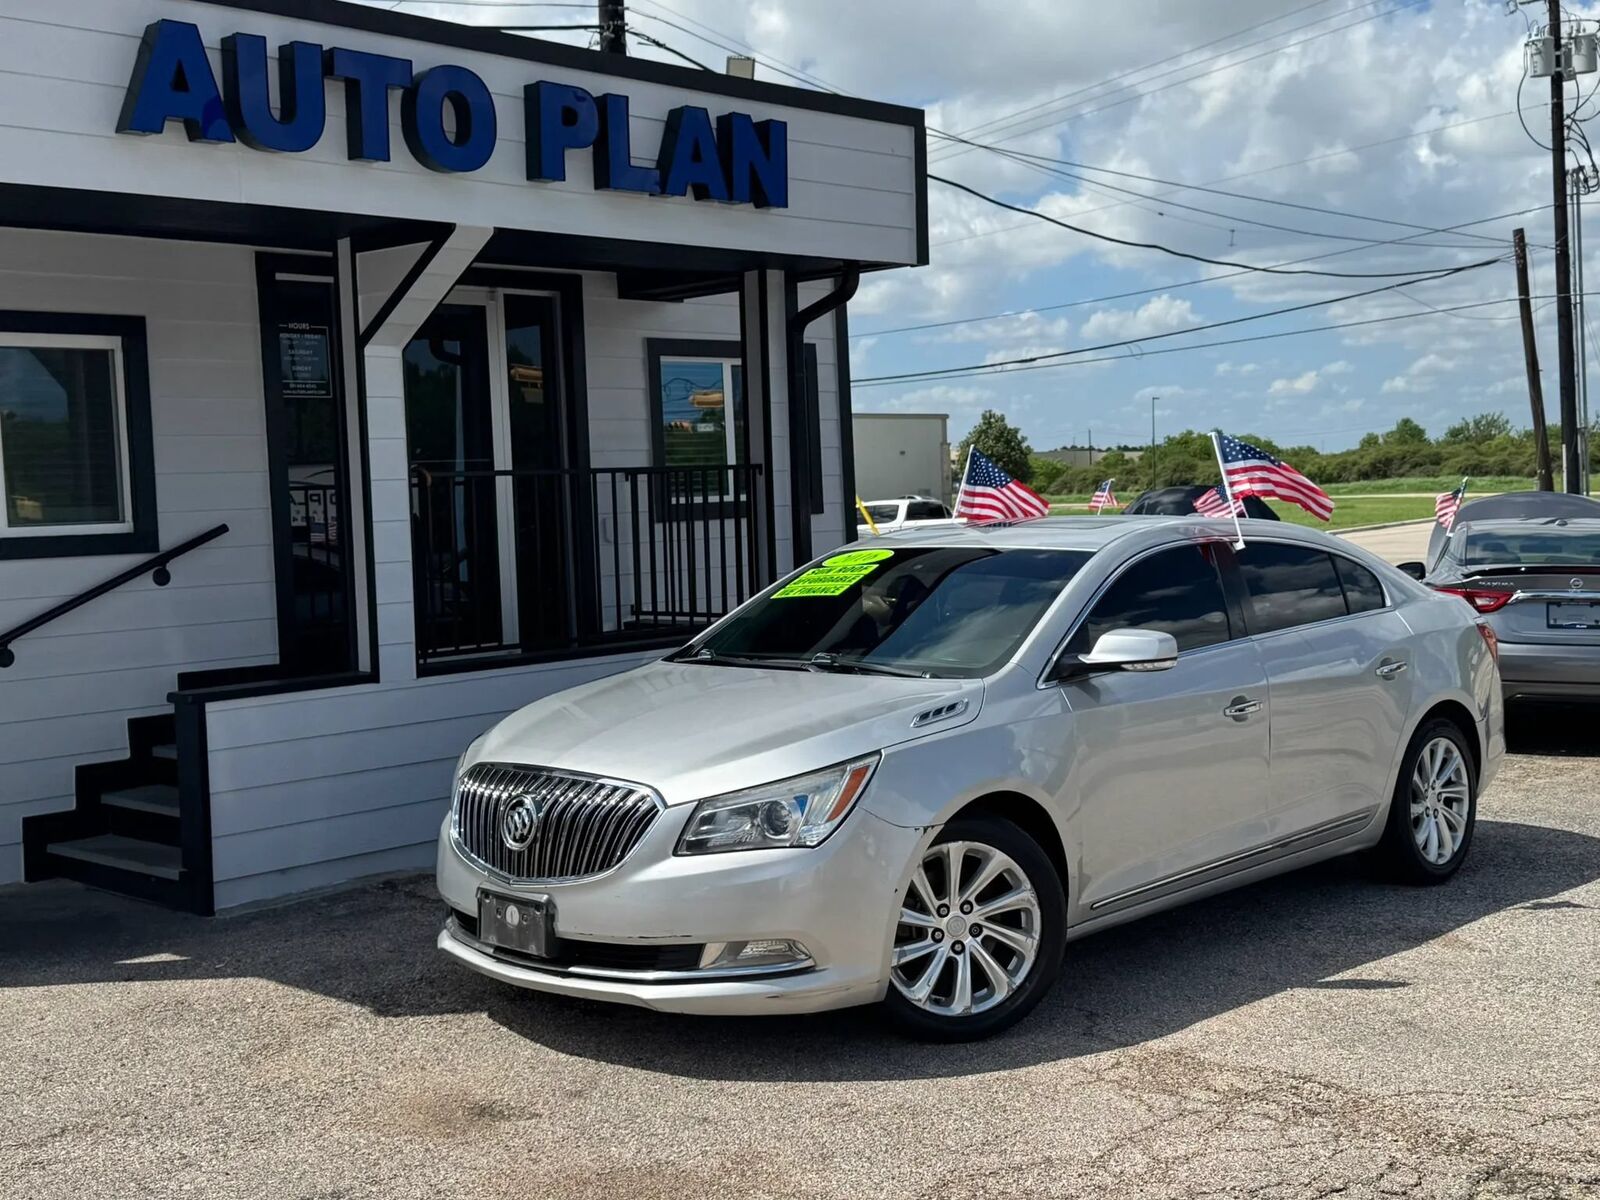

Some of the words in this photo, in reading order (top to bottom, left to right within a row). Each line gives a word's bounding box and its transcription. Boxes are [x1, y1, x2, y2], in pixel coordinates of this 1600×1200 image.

[115, 18, 498, 173] AUTO
[523, 80, 789, 209] PLAN
[288, 322, 310, 330] HOURS
